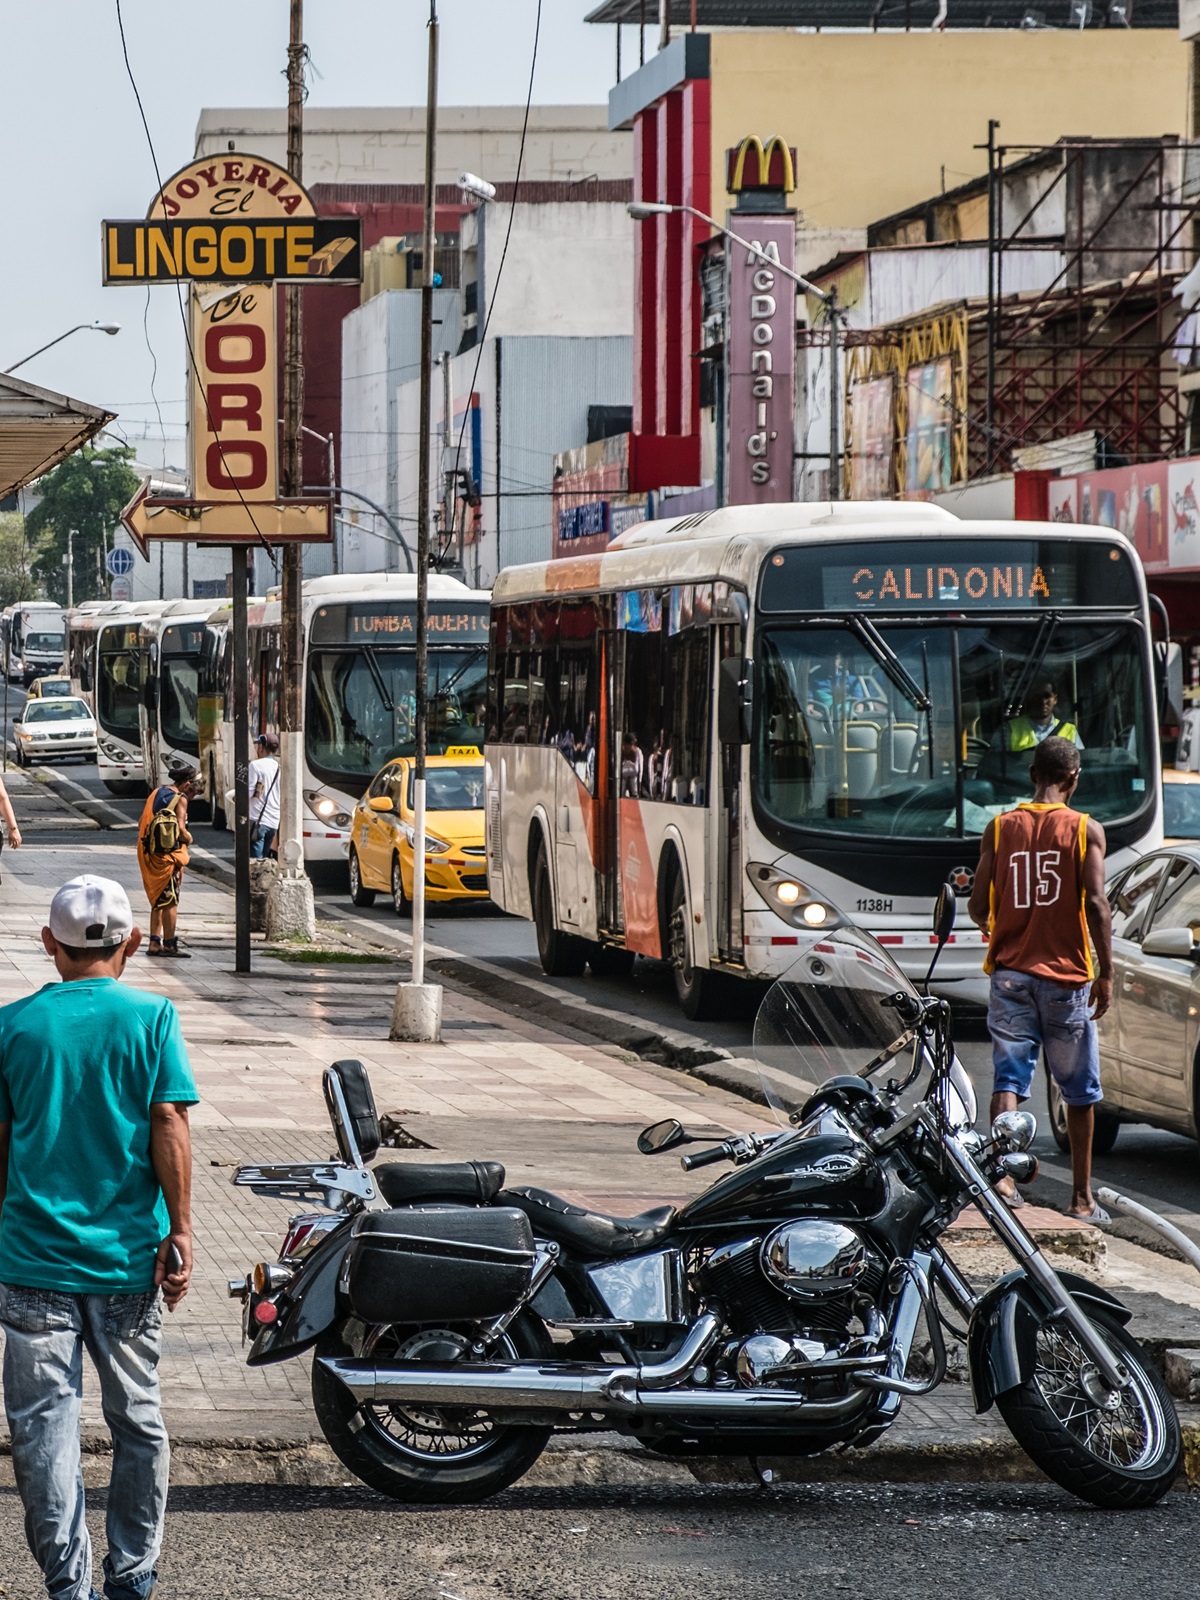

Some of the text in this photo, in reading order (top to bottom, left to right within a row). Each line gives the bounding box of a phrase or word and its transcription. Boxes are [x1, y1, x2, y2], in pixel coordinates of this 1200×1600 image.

[161, 161, 304, 216] JOYERIA
[209, 188, 255, 214] El
[108, 225, 314, 277] LINGOTE
[745, 239, 781, 486] McDonald's
[204, 323, 268, 491] ORO
[852, 566, 1050, 599] CALIDONIA
[856, 898, 893, 912] 1138H
[1009, 850, 1062, 909] 15
